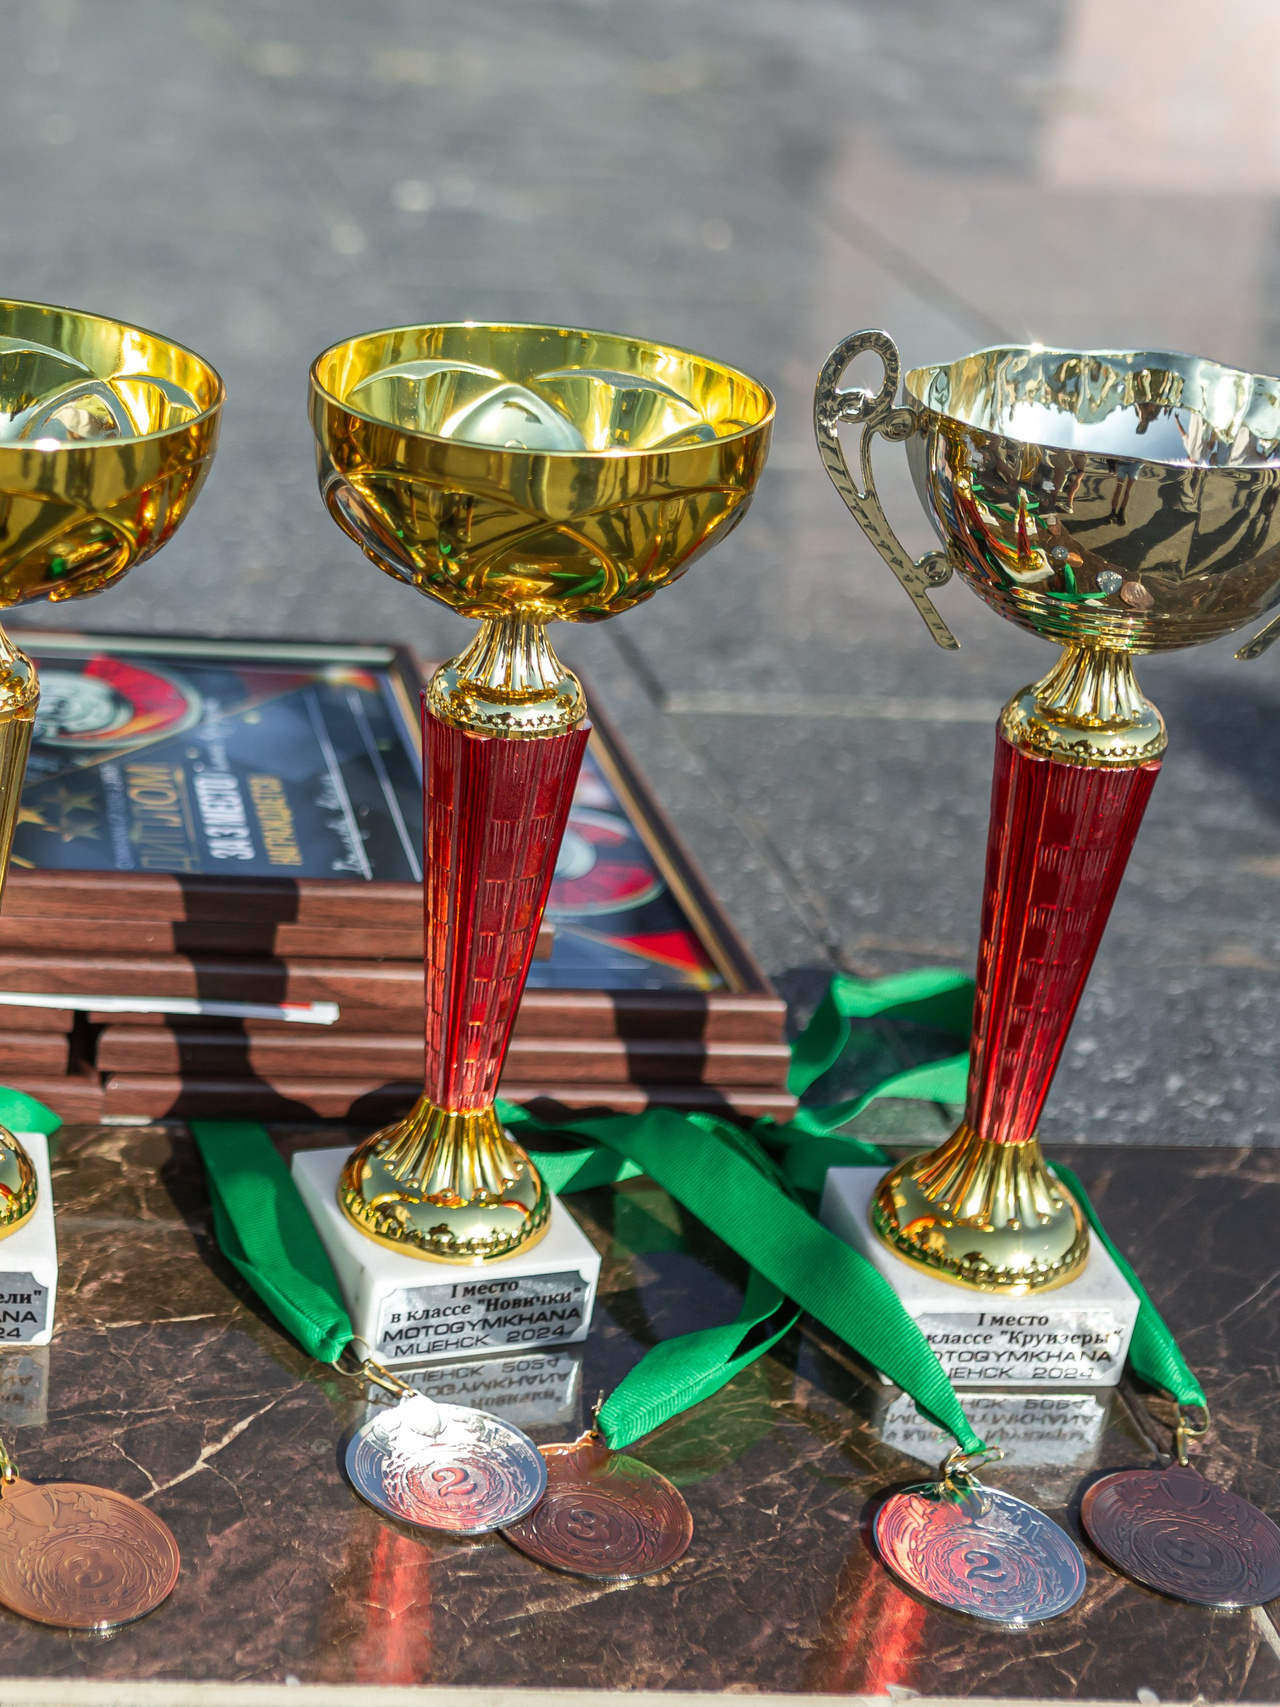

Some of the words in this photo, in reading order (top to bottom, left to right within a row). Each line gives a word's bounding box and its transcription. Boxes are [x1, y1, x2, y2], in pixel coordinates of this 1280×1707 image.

[390, 1312, 402, 1324] в
[405, 1303, 471, 1322] классе
[477, 1286, 582, 1312] "Новички"
[462, 1280, 519, 1298] место
[382, 1307, 581, 1343] MOTOGYMKHANA
[990, 1314, 1049, 1327] место
[394, 1334, 489, 1357] МЦЕНСК
[506, 1325, 565, 1343] 2024
[926, 1333, 993, 1345] классе
[1031, 1366, 1095, 1379] 2024
[431, 1466, 478, 1497] 2
[566, 1508, 610, 1540] 3
[63, 1550, 116, 1588] 3
[964, 1550, 1008, 1584] 2
